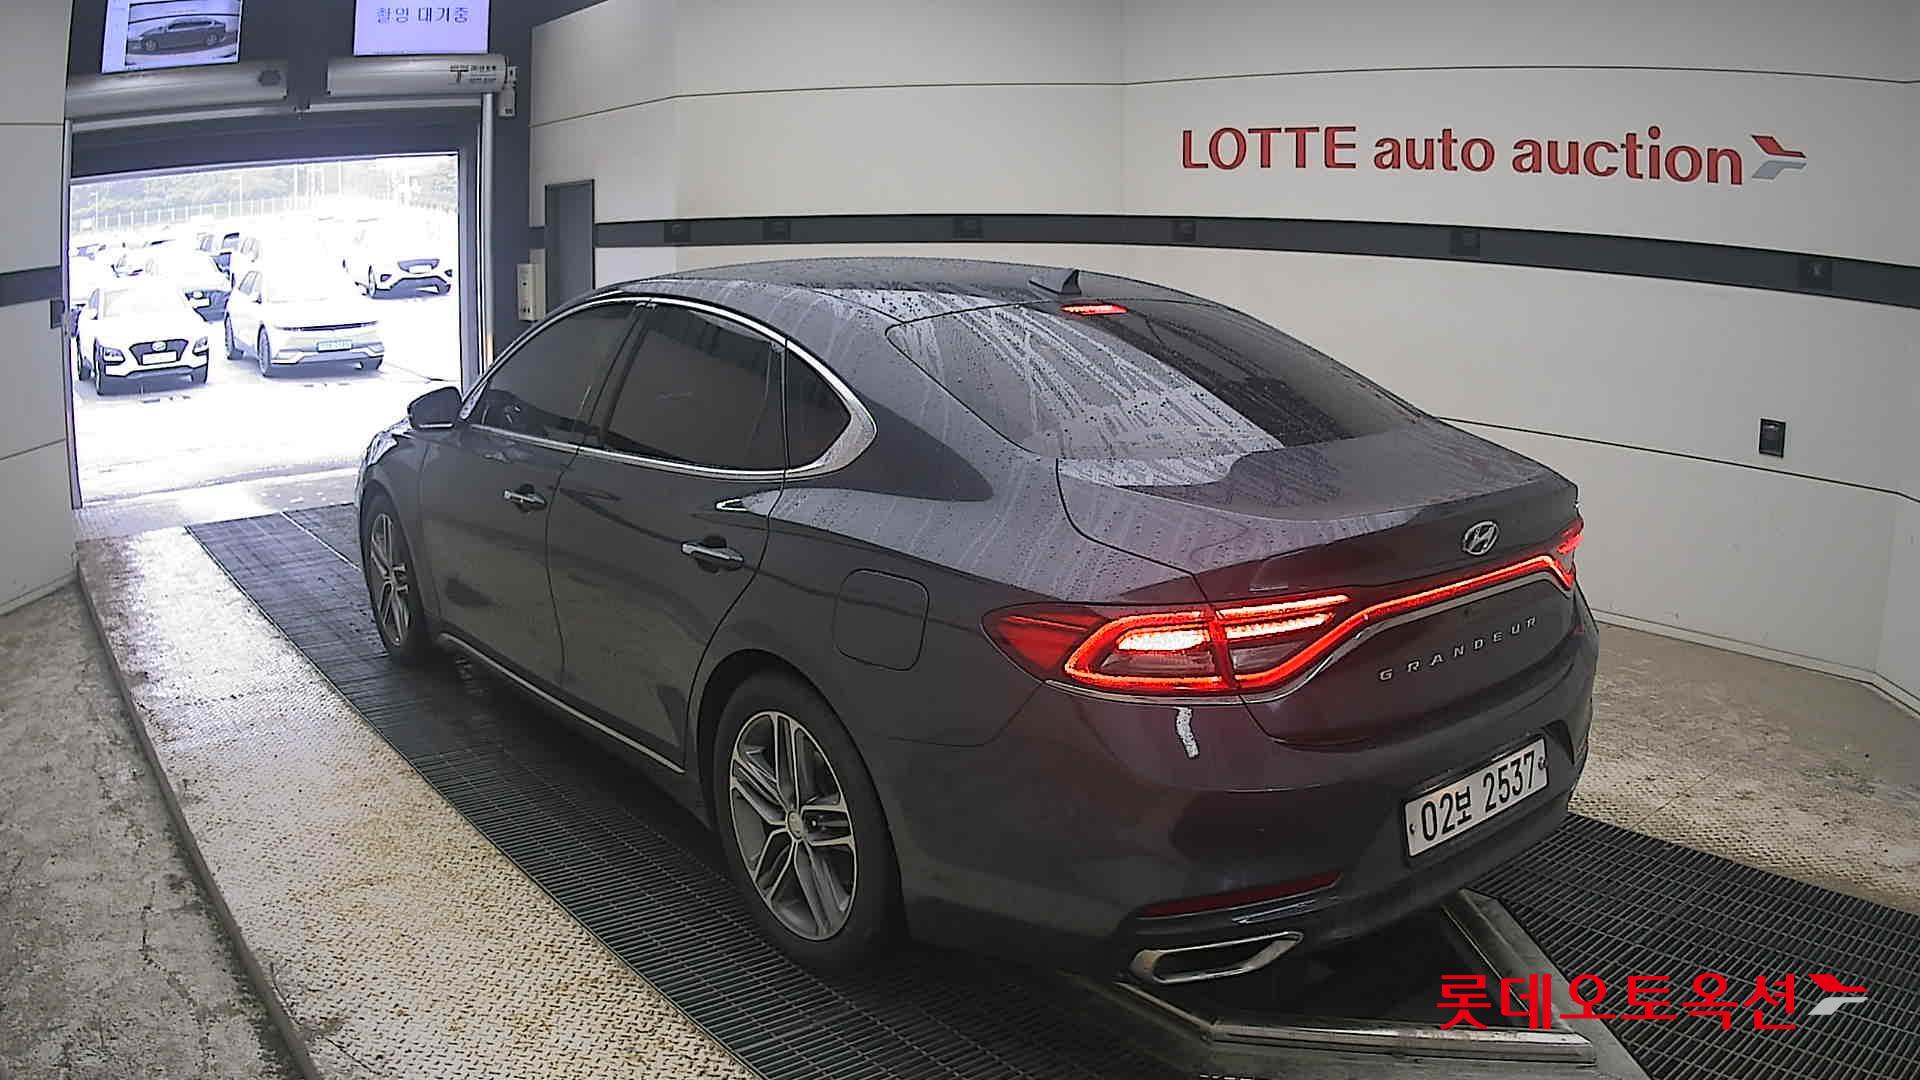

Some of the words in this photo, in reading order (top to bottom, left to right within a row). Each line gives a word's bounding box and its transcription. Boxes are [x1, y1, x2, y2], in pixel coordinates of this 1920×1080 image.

[418, 7, 470, 24] 대기중
[1182, 126, 1357, 170] LOTTE
[1373, 128, 1496, 172] auto
[1512, 126, 1743, 185] auction
[1379, 616, 1537, 681] GRANDEUR
[1421, 786, 1472, 841] 02보
[1482, 750, 1535, 813] 2537
